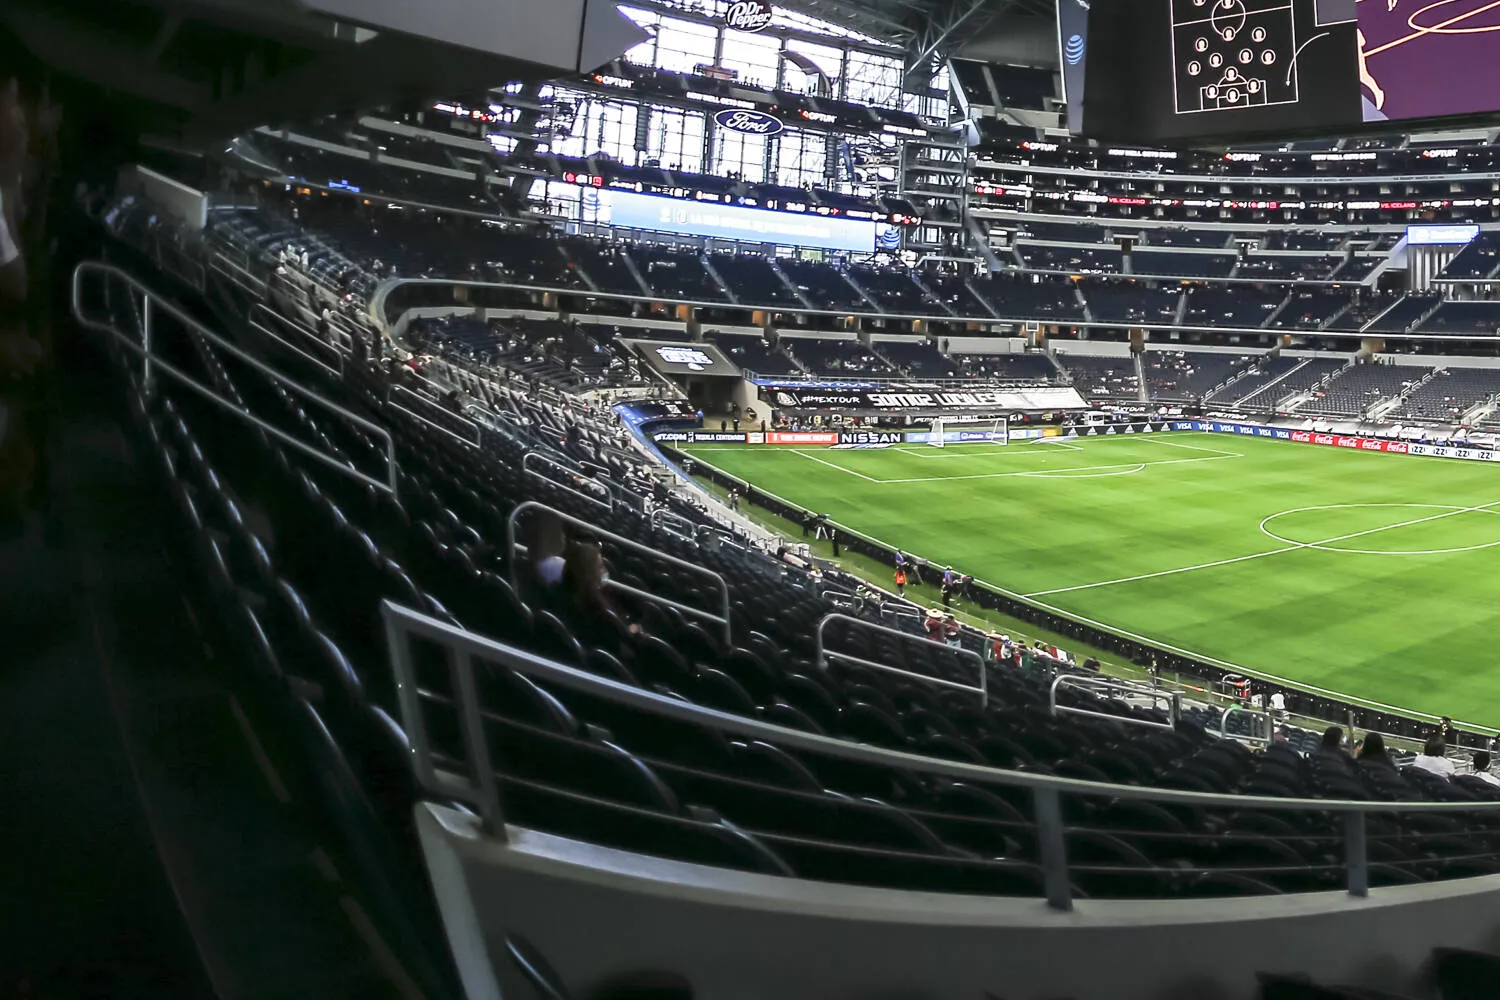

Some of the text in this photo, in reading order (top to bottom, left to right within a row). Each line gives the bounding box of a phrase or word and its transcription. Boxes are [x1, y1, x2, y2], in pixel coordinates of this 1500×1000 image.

[748, 2, 763, 14] Dr
[730, 2, 770, 28] Pepper
[726, 112, 771, 133] Ford
[802, 395, 861, 405] #MEXTOUR
[1177, 422, 1192, 430] VISA
[1199, 423, 1214, 431] VISA
[1219, 425, 1235, 433] VISA
[1239, 427, 1254, 435] VISA
[1258, 428, 1272, 436] VISA
[1276, 430, 1290, 439] VISA
[841, 432, 901, 443] NISSAN
